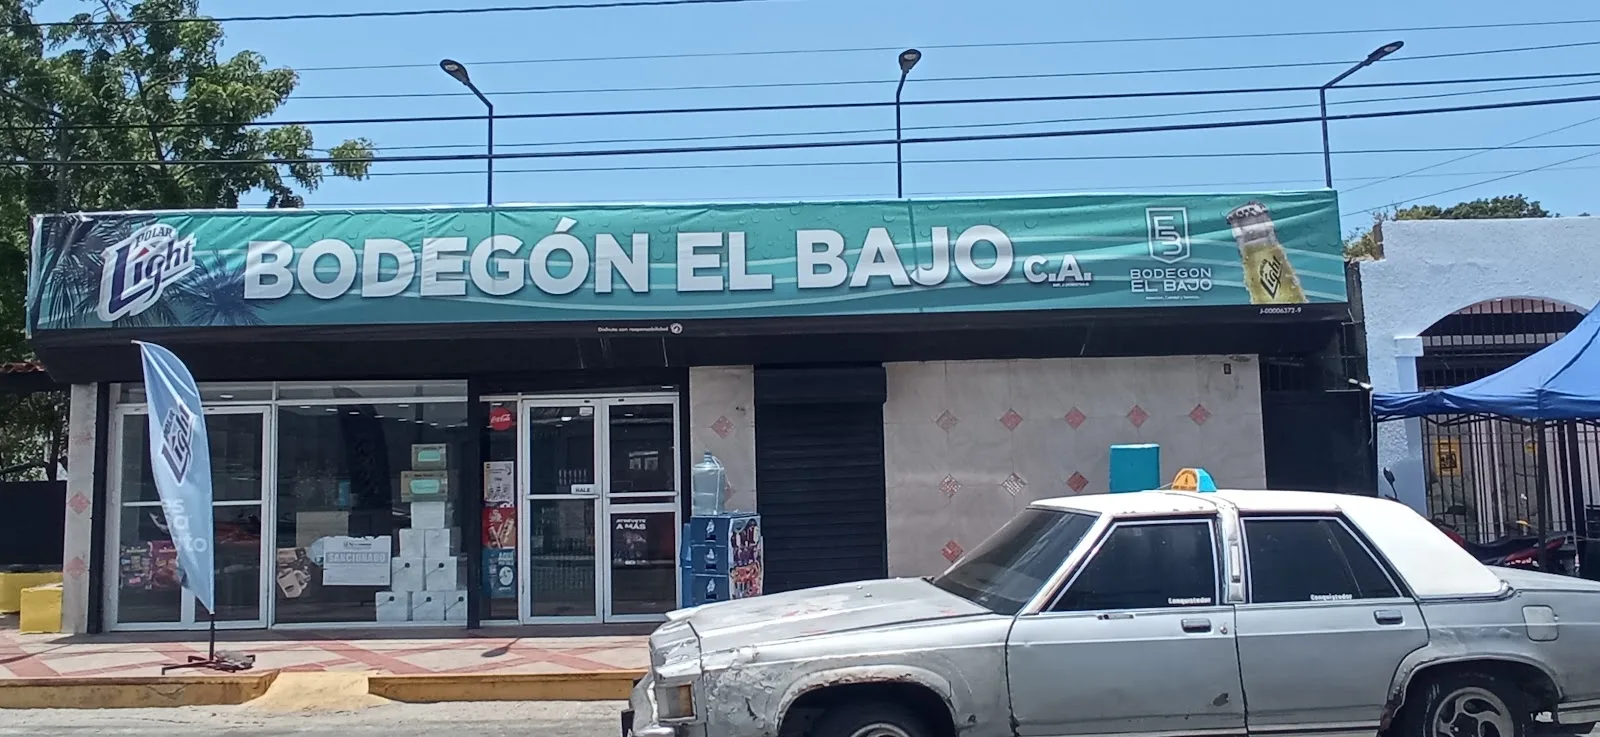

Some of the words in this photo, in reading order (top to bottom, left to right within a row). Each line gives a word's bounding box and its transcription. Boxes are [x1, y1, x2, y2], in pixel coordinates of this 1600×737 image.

[136, 227, 173, 248] POLAR
[244, 216, 649, 300] BODEGÓN
[677, 231, 773, 292] EL
[796, 224, 1014, 289] BAJO
[1023, 254, 1092, 283] C.A.
[109, 240, 194, 314] Light
[1129, 267, 1212, 280] BODEGON
[1131, 279, 1159, 293] EL
[1163, 278, 1213, 292] BAJO
[161, 404, 192, 484] Light
[328, 552, 387, 562] SANCIONADO
